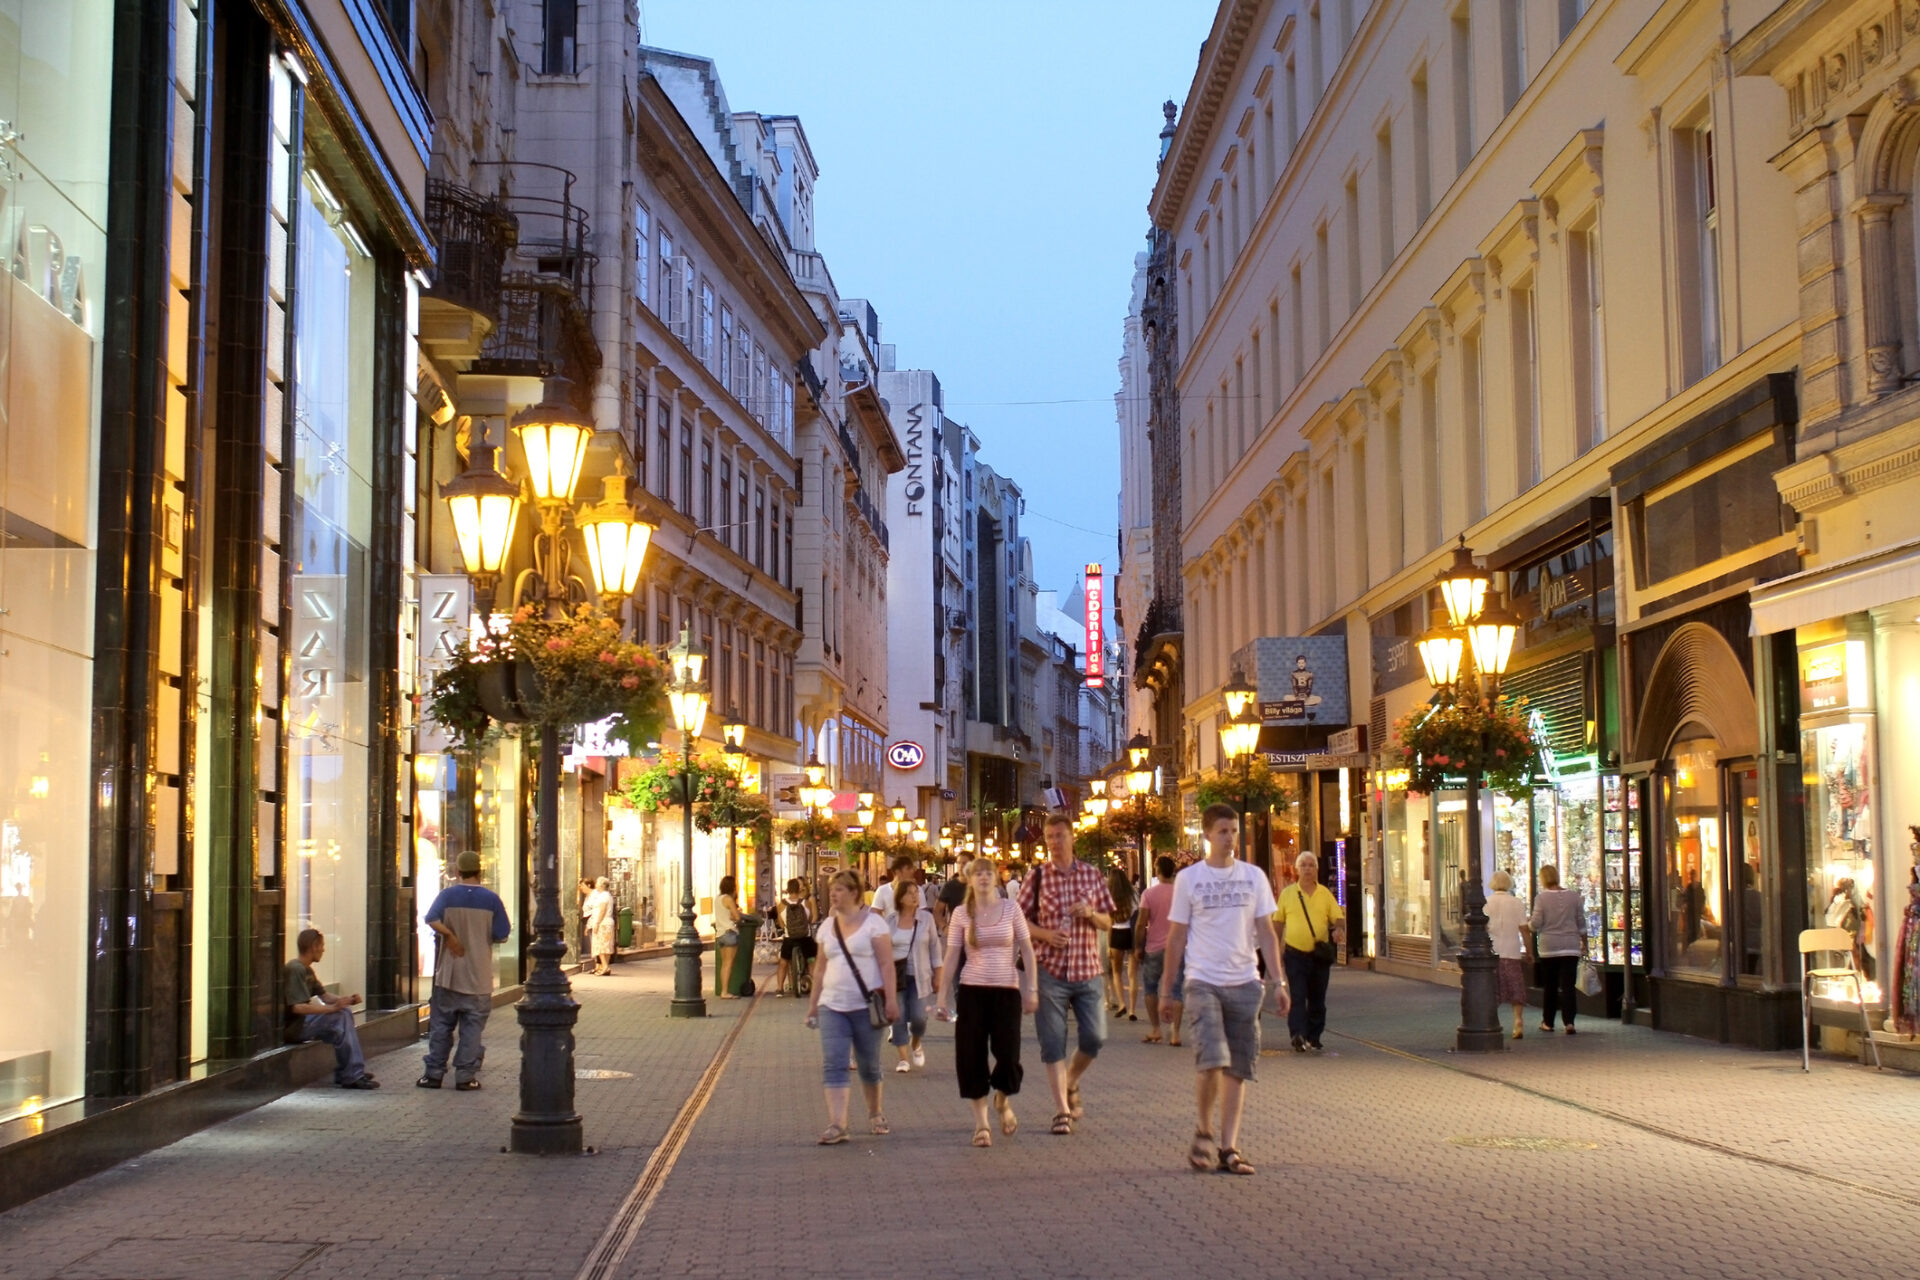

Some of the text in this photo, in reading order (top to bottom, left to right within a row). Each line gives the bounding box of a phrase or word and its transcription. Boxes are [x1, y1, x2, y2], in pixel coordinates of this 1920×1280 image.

[905, 402, 925, 517] FONTANA
[1087, 579, 1101, 673] McDonald's
[892, 748, 919, 763] C&A
[1314, 755, 1359, 768] ESPRIT
